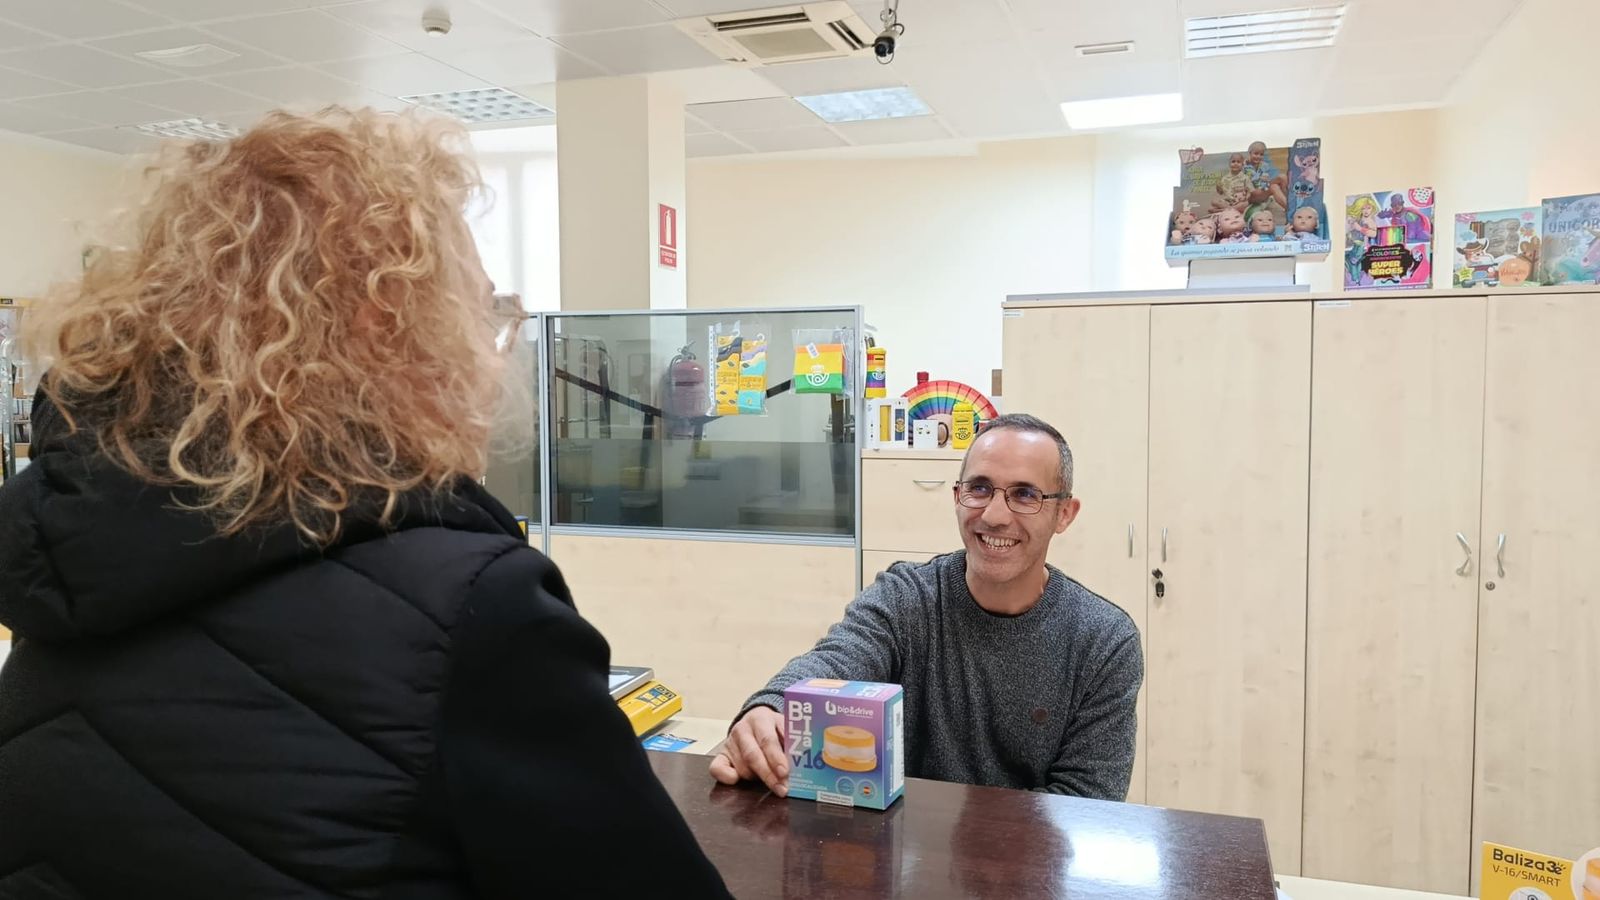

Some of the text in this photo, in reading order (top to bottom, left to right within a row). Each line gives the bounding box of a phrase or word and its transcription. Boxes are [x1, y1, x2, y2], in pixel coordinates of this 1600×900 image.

[1371, 260, 1401, 269] SUPER
[837, 705, 874, 716] bip&drive
[792, 748, 826, 770] v16
[1492, 864, 1561, 887] V-16/SMART
